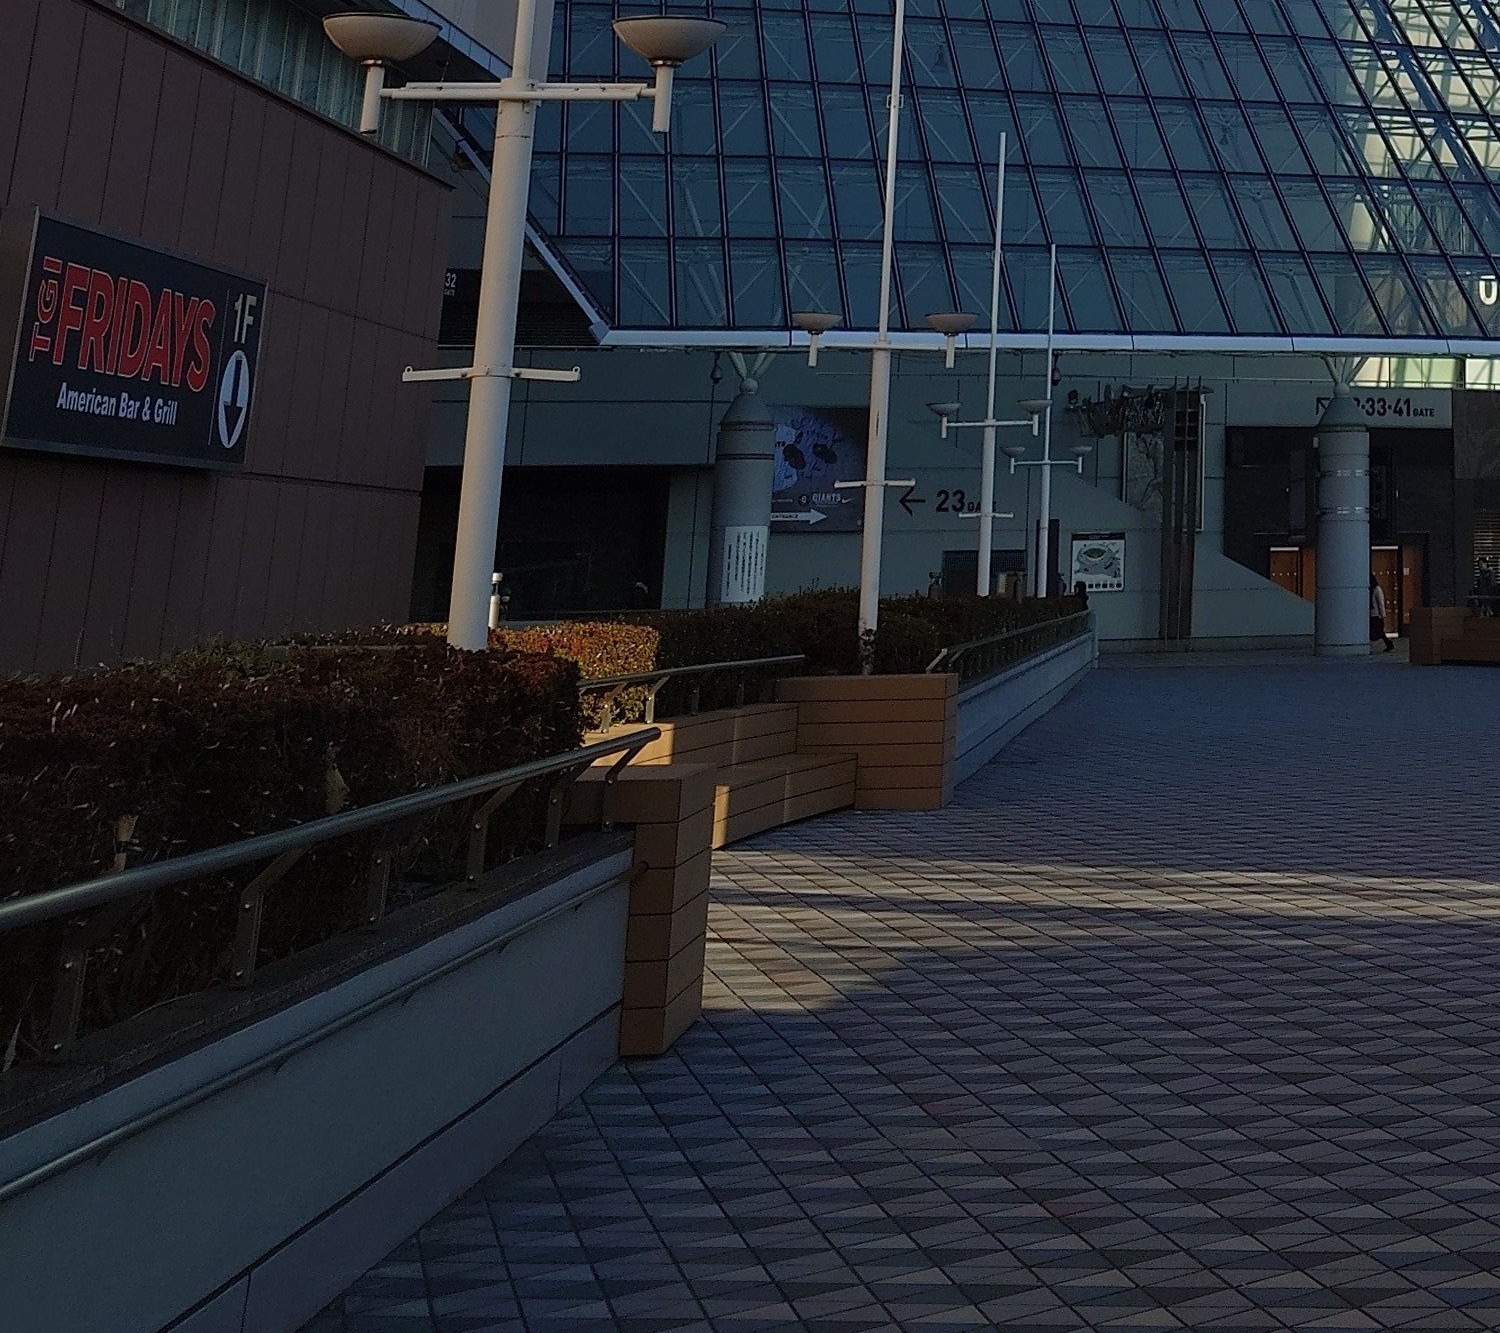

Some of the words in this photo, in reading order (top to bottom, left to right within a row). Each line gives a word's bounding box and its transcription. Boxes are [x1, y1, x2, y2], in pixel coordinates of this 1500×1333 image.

[29, 256, 63, 363] TGI
[52, 263, 216, 393] FRIDAYS
[234, 293, 258, 345] 1F
[56, 381, 118, 412] American
[118, 391, 141, 420] Bar
[142, 396, 152, 420] &
[154, 399, 178, 426] Grill
[1412, 408, 1436, 418] GATE
[812, 492, 842, 502] GIANTS
[935, 489, 966, 513] 23
[967, 500, 998, 513] GAE
